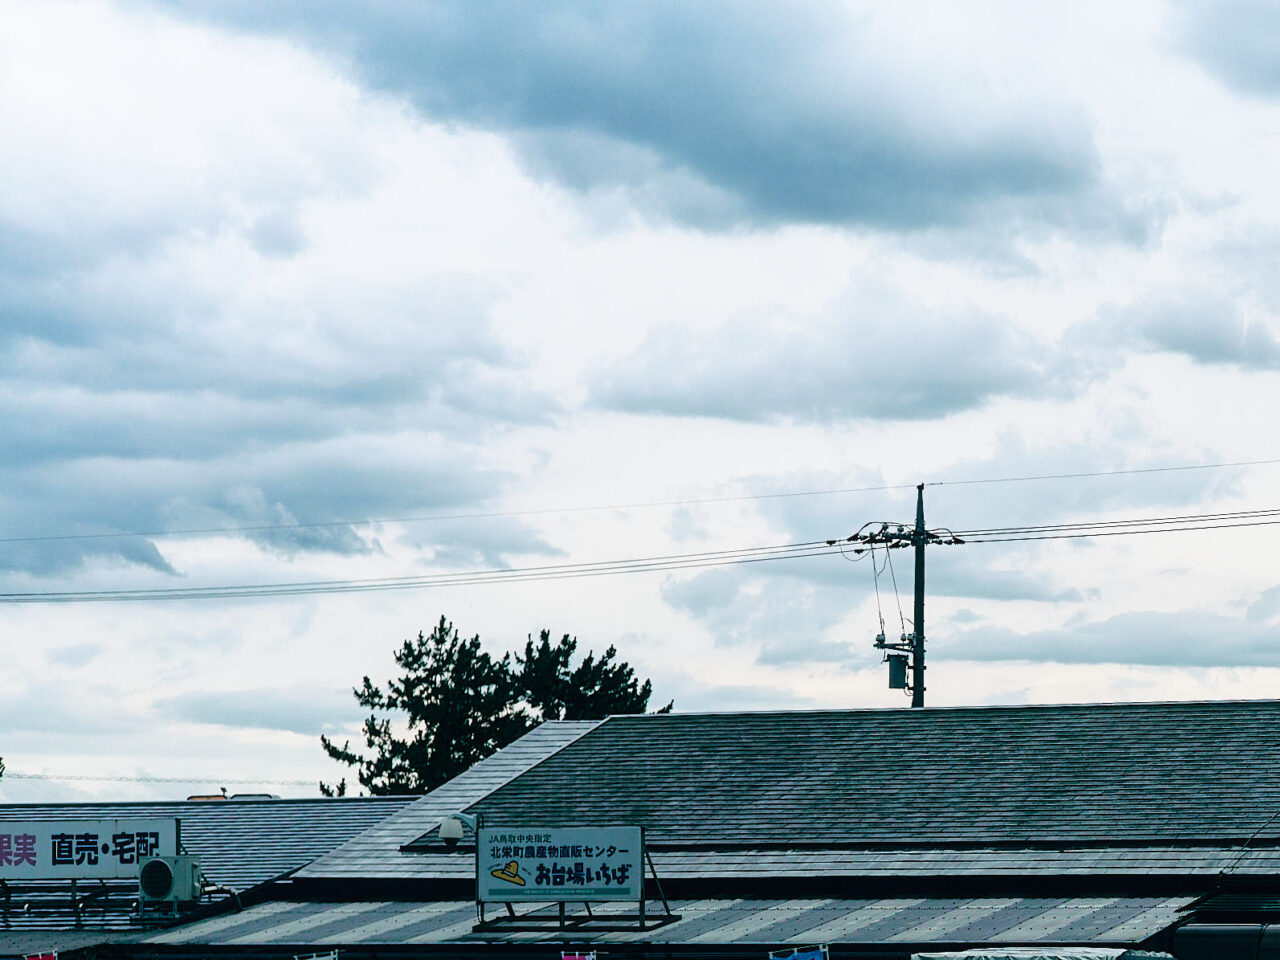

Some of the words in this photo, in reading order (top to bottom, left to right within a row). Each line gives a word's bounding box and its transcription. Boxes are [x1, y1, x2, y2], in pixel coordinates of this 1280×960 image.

[535, 862, 632, 886] お台場いちば
